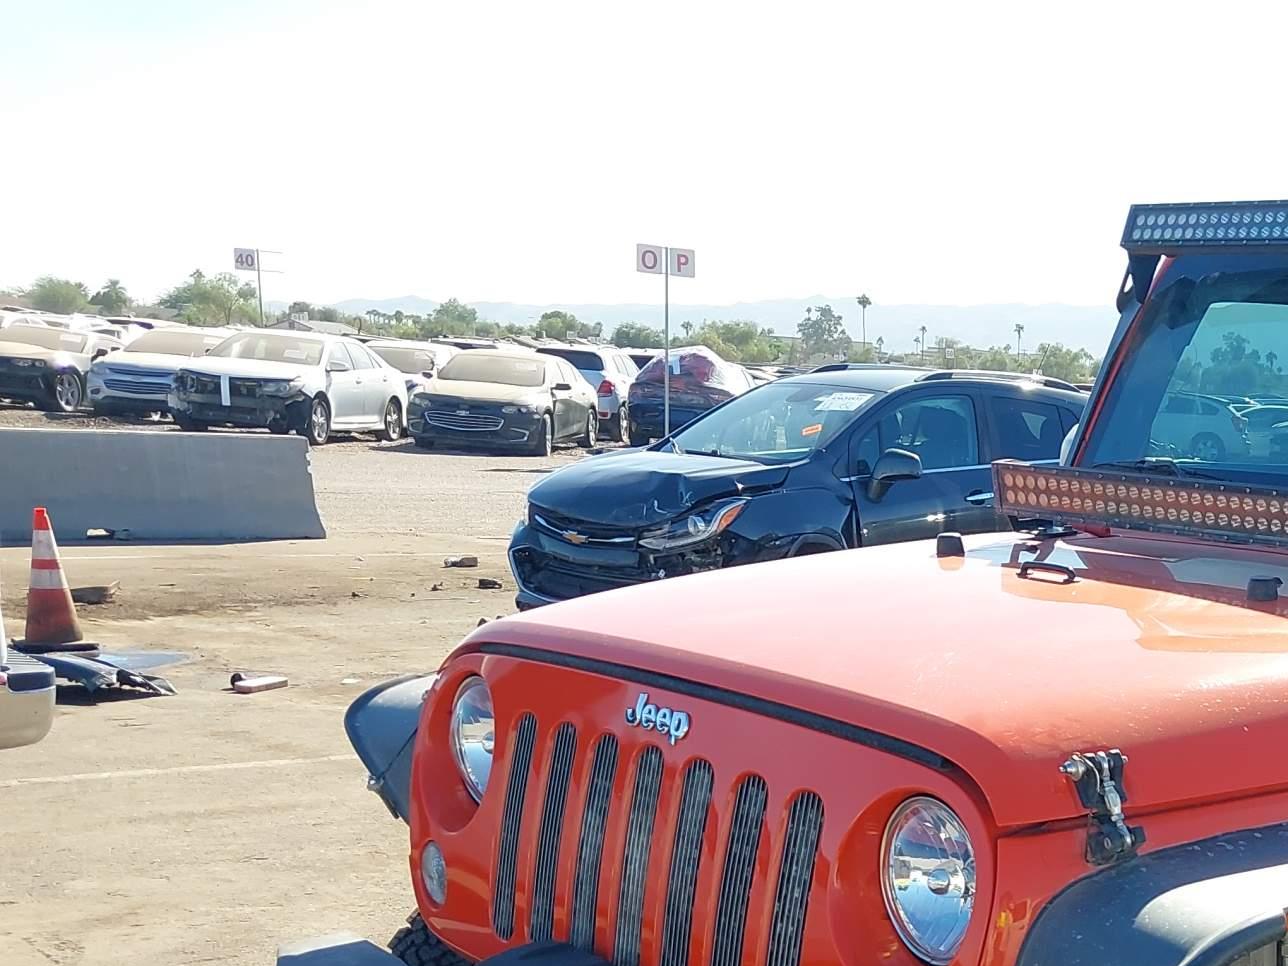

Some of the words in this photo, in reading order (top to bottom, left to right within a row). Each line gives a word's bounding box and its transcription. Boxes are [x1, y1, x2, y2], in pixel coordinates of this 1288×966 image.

[235, 254, 254, 267] 40
[676, 253, 689, 272] P
[625, 692, 691, 746] Jeep
